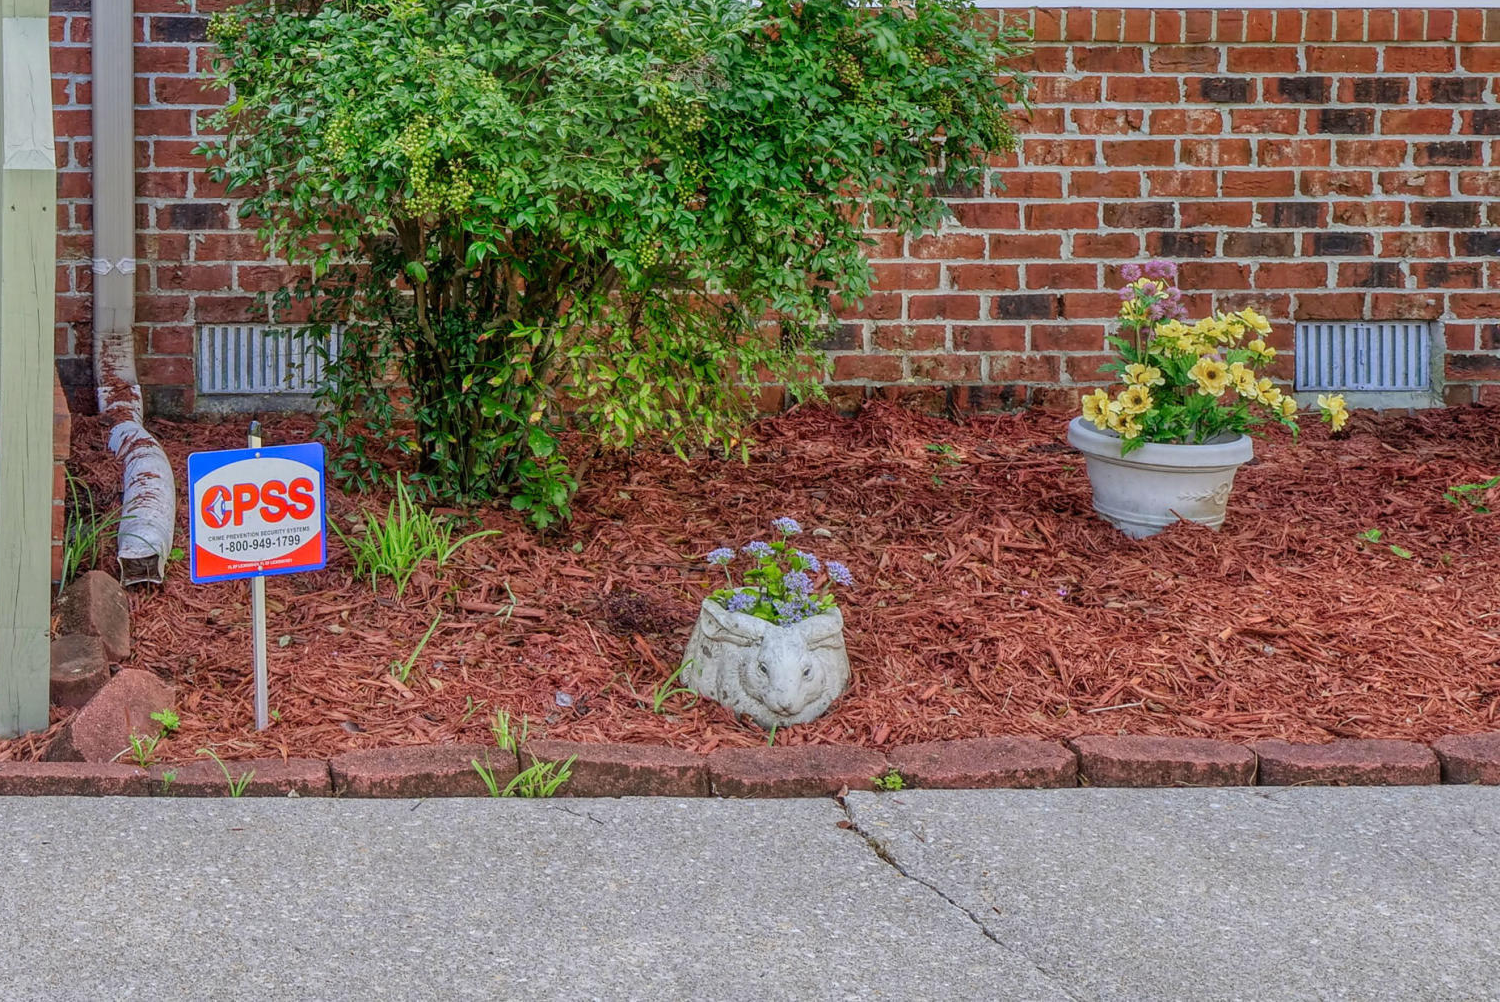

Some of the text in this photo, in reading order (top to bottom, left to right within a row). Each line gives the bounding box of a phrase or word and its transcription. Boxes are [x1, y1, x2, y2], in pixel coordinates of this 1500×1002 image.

[200, 477, 316, 530] CPSS
[226, 531, 260, 540] PREVENTION
[260, 529, 286, 537] SECURITY
[287, 526, 310, 534] SYSTEMS
[219, 534, 301, 553] 1-800-949-1799
